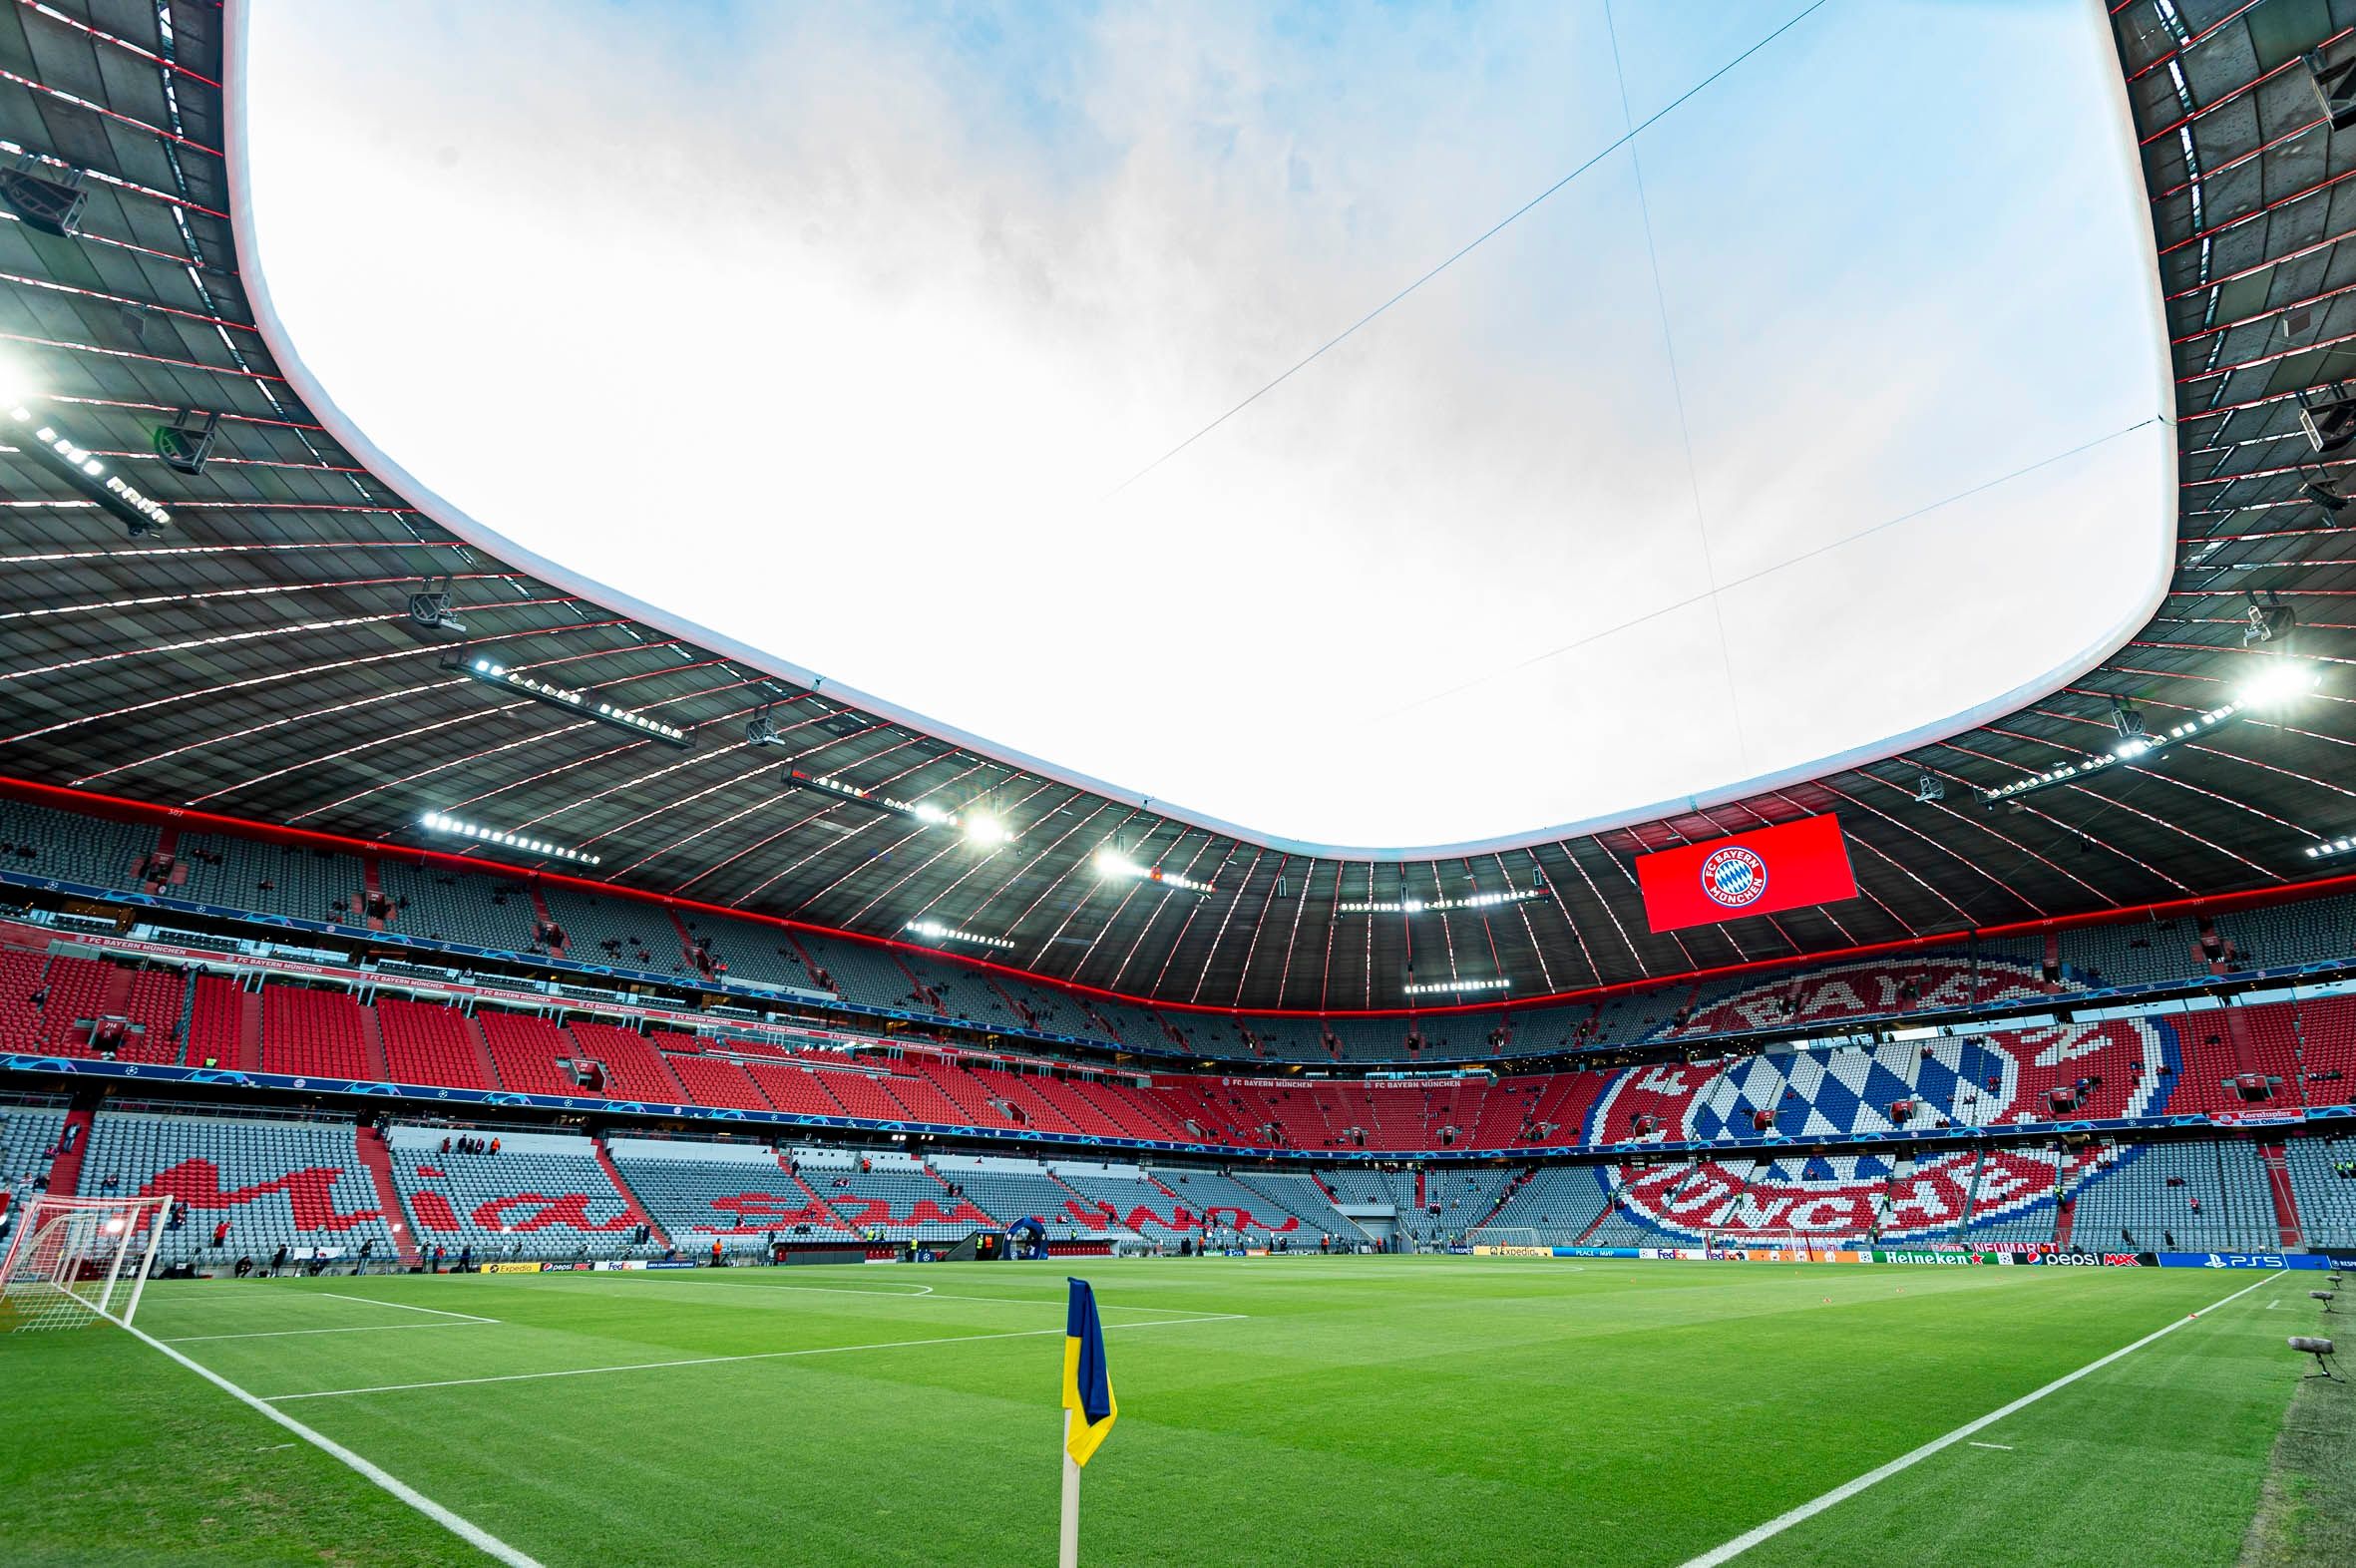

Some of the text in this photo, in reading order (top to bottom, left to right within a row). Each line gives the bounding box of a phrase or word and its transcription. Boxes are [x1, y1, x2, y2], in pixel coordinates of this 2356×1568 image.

[168, 807, 185, 817] 307
[1706, 850, 1760, 877] FC BAYERN
[1710, 878, 1763, 903] MÜNCHEN
[103, 939, 142, 950] BAYERN
[143, 943, 187, 956] MÜNCHEN
[250, 958, 282, 969] BAYERN
[284, 962, 322, 974] MÜNCHEN
[380, 977, 411, 985] BAYERN
[413, 980, 446, 989] MÜNCHEN
[521, 992, 552, 1002] MÜNCHEN
[596, 1003, 618, 1012] BAYERN
[619, 1006, 646, 1015] MÜNCHEN
[1276, 1079, 1313, 1088] MÜNCHEN
[1421, 1079, 1461, 1088] MÜNCHEN
[1658, 1249, 1687, 1260] FedEx
[1886, 1251, 1968, 1265] Heineken
[2046, 1252, 2142, 1268] pepsi MAX
[608, 1261, 632, 1271] FedEx
[2230, 1256, 2282, 1267] PS5
[500, 1264, 532, 1273] Expedia
[553, 1263, 573, 1272] pepsi
